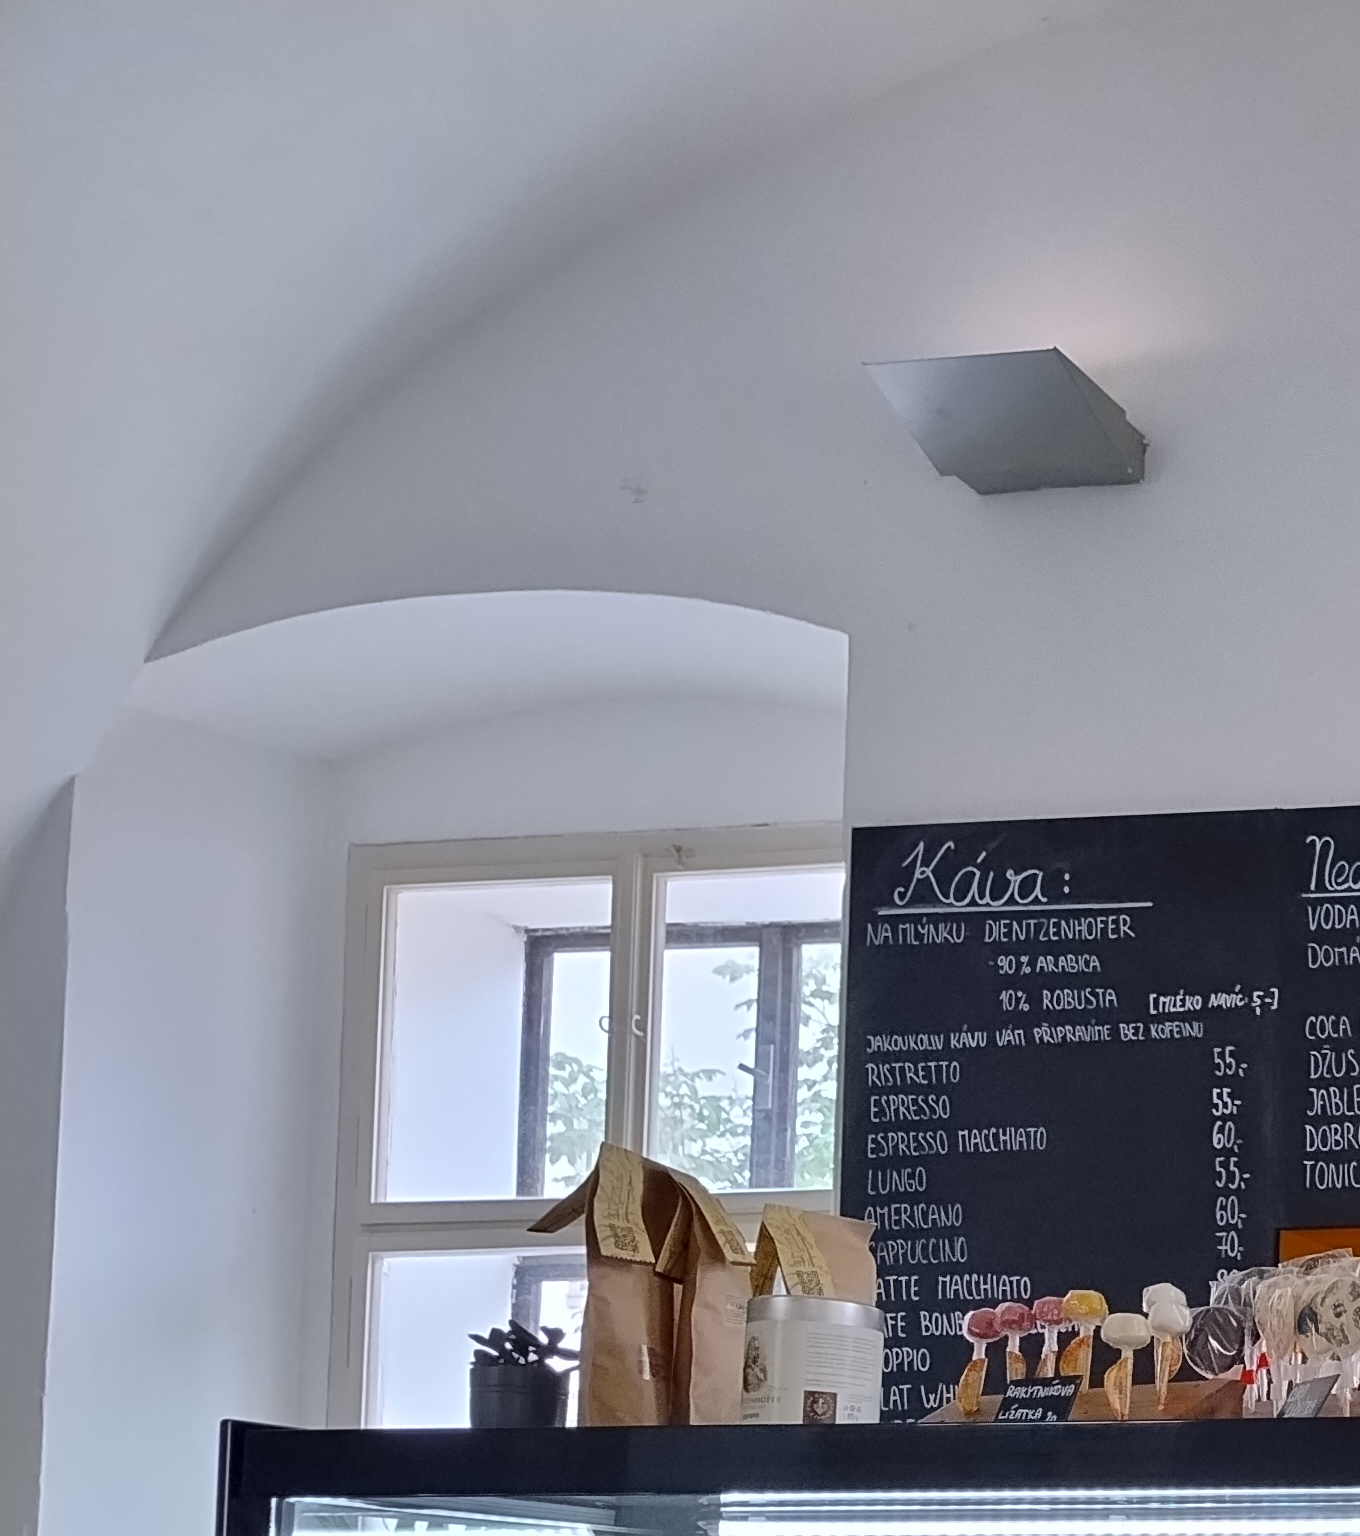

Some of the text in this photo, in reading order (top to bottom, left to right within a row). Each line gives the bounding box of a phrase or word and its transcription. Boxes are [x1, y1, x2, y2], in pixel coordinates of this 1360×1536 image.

[867, 914, 1135, 946] NA DIENTZENHOFER
[1308, 901, 1359, 931] VODA
[1037, 955, 1101, 973] ARABICA
[1043, 990, 1117, 1010] ROBUSTA
[866, 1023, 1145, 1052] JAKOUKOLIV KÁVU VÁM BEZ
[1306, 1015, 1351, 1039] COCA
[866, 1061, 959, 1087] RISTRETTO
[1309, 1044, 1359, 1079] DŽUS
[871, 1095, 950, 1122] ESPRESSO
[868, 1127, 1047, 1158] ESPRESSO MACCHIATO
[868, 1167, 927, 1195] LUNGO
[1303, 1160, 1360, 1189] TONIC
[864, 1203, 963, 1231] AMERICANO
[938, 1276, 1031, 1300] MACCHIATO
